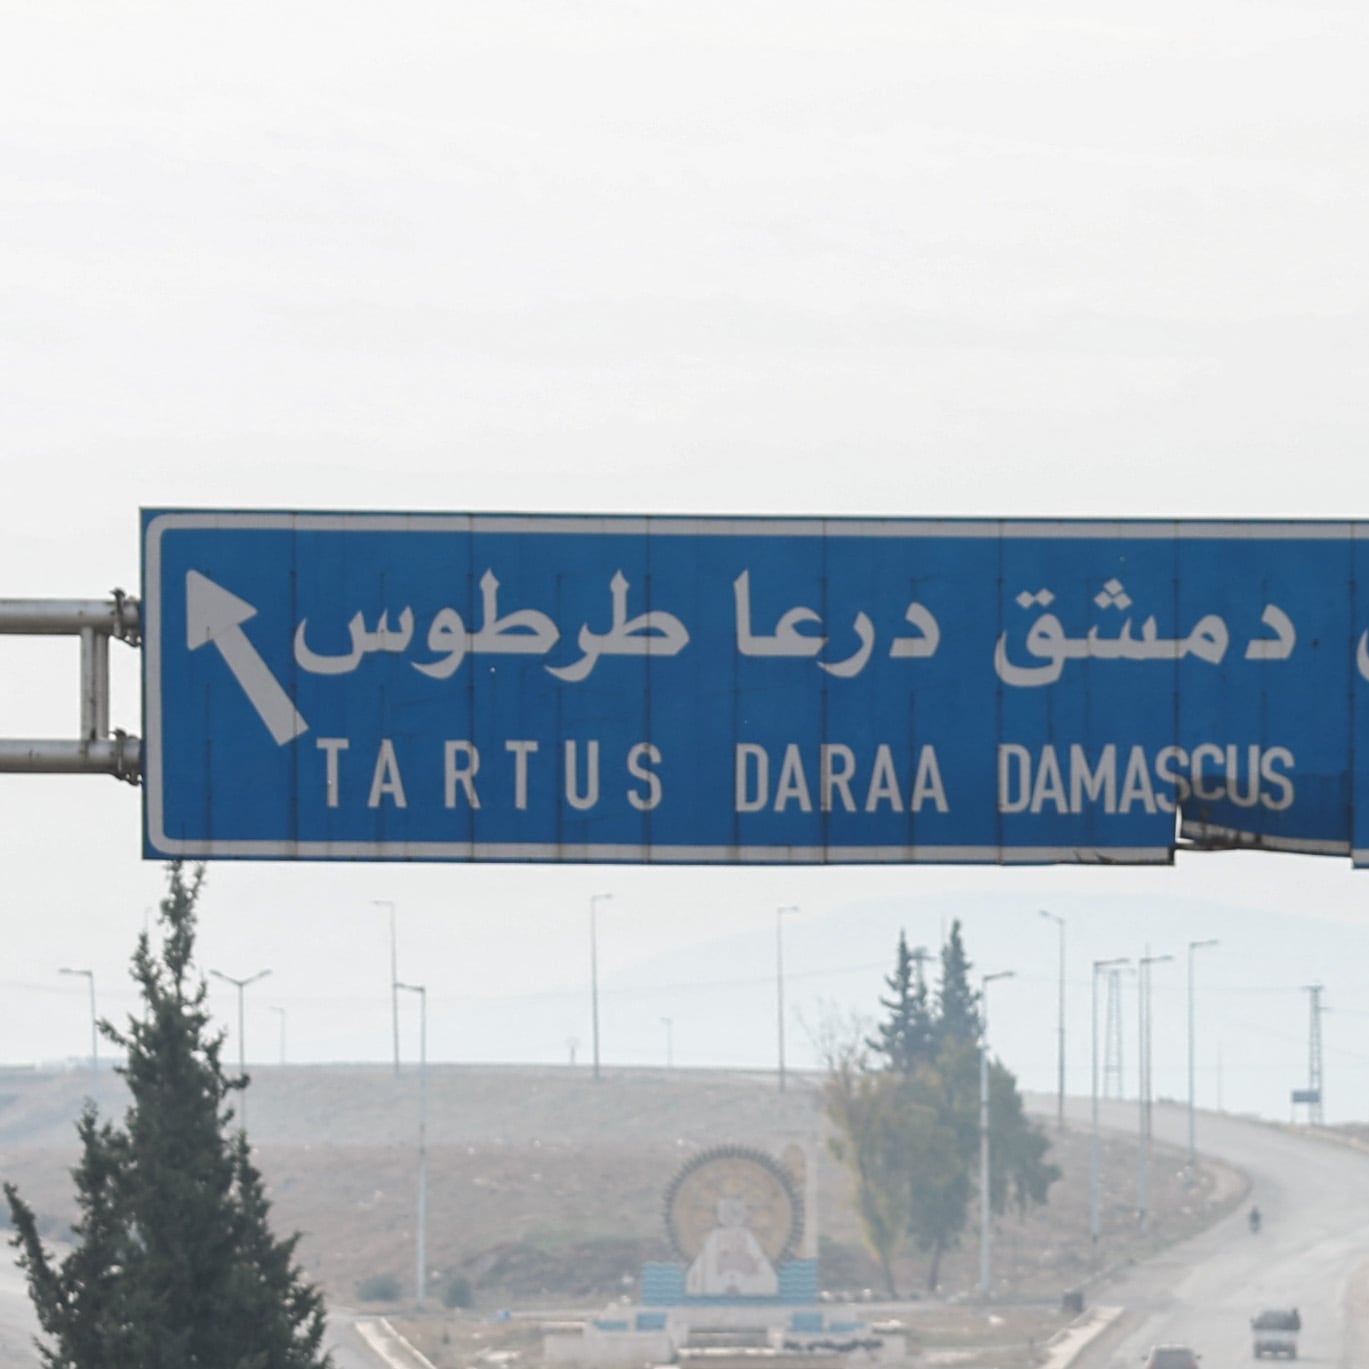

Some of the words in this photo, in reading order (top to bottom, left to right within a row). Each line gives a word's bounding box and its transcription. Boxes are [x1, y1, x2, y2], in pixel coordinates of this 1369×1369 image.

[293, 569, 691, 682] طرطوس
[733, 570, 941, 678] درعا
[994, 579, 1297, 687] دمشق
[316, 737, 663, 810] TARTUS
[735, 743, 949, 813] DARAA
[997, 742, 1296, 814] DAMASCUS
